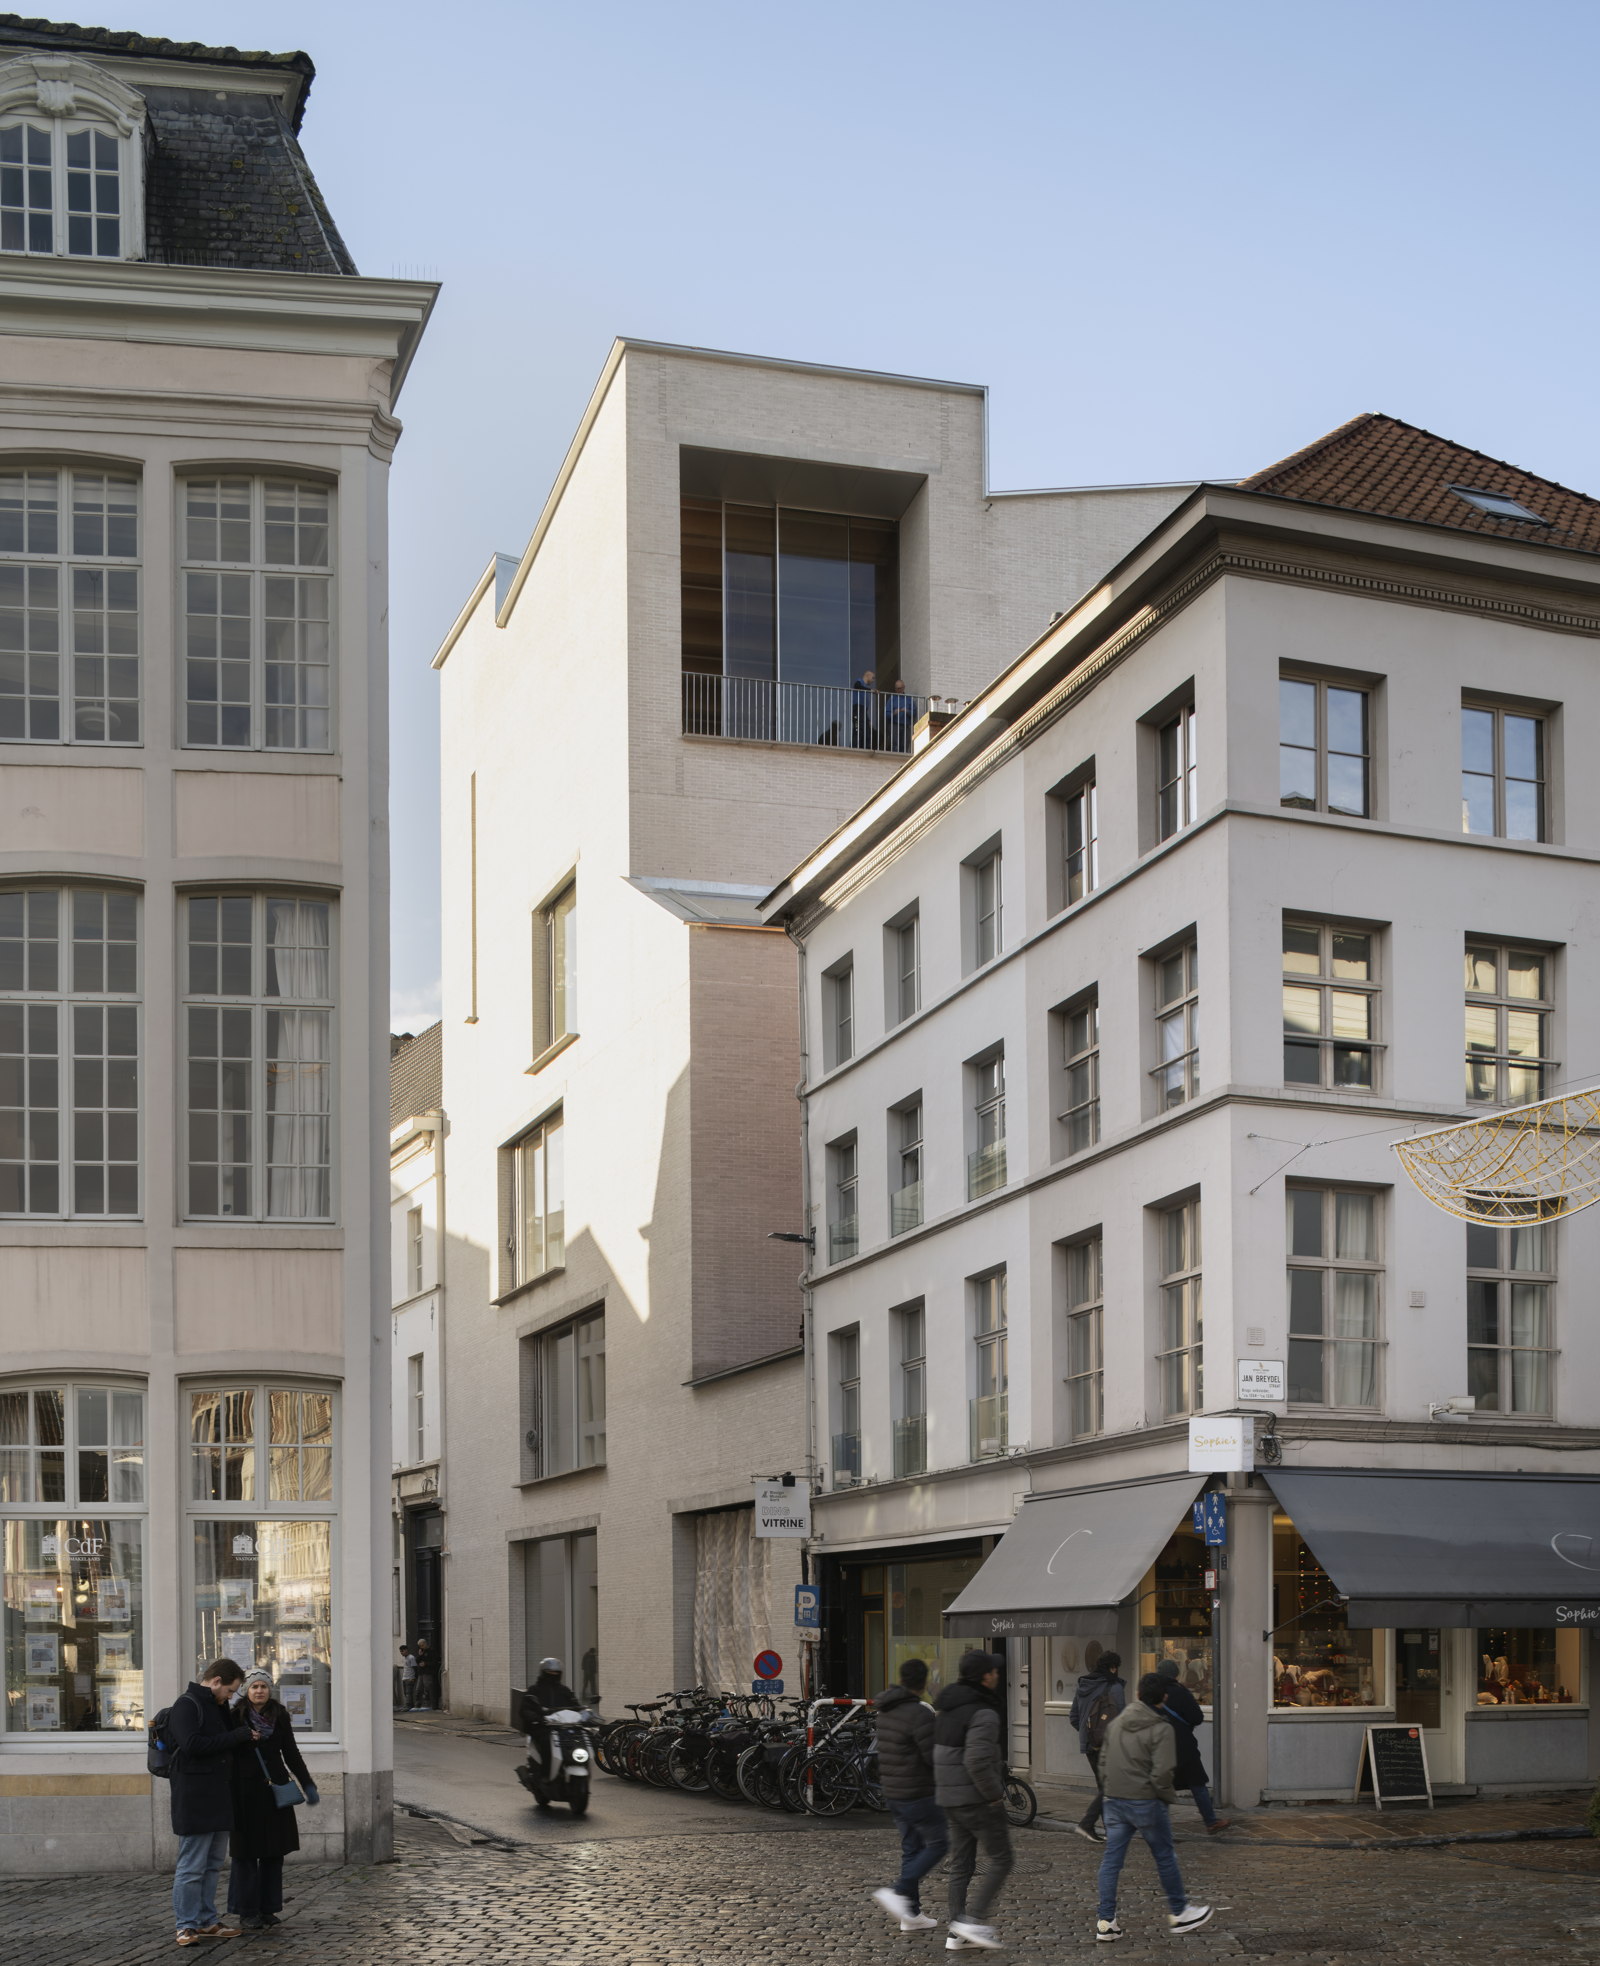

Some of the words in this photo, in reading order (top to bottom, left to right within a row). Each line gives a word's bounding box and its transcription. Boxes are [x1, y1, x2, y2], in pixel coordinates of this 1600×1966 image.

[1242, 1374, 1253, 1382] JAN
[1256, 1375, 1281, 1383] BREYDEL
[1194, 1435, 1238, 1448] Sophie's
[762, 1506, 790, 1516] DING
[762, 1518, 804, 1528] VITRINE
[64, 1537, 103, 1555] CdF
[798, 1591, 816, 1620] P
[991, 1617, 1016, 1633] Sophie's
